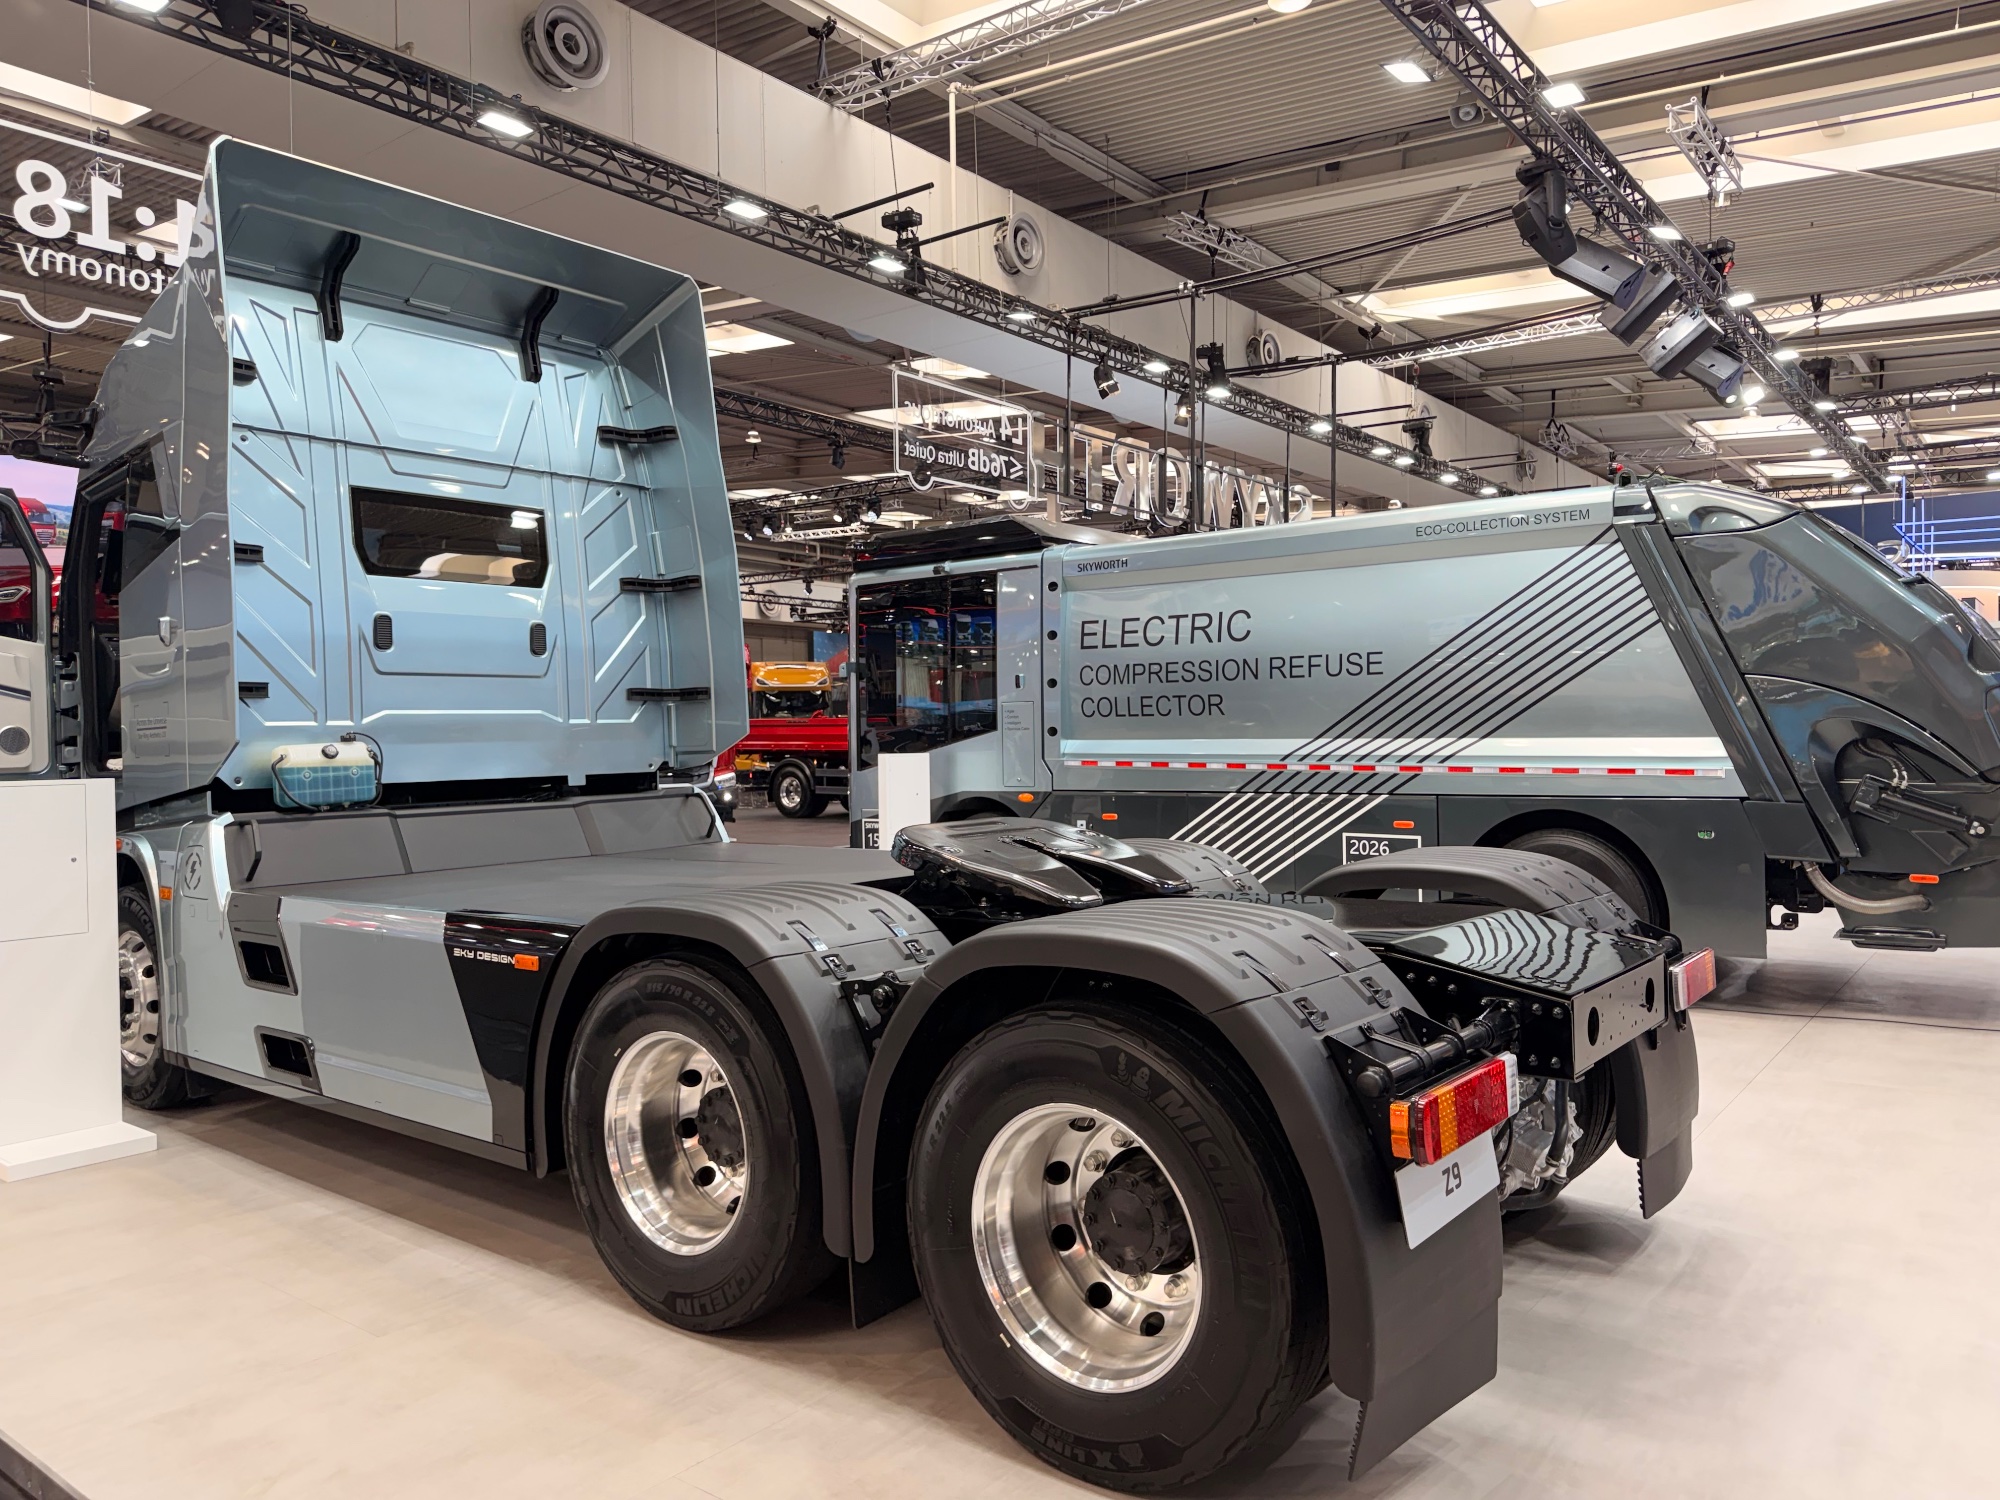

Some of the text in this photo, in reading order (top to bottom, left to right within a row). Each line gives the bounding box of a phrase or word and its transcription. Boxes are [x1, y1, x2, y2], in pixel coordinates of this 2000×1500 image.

[1415, 508, 1590, 537] ECO-COLLECTION SYSTEM
[1077, 559, 1128, 573] SKYWORTH
[1080, 609, 1252, 650] ELECTRIC
[1079, 651, 1384, 686] COMPRESSION REFUSE
[1080, 694, 1226, 718] COLLECTOR
[1349, 839, 1390, 856] 2026
[453, 948, 515, 965] SKY DESIGN
[682, 988, 693, 1000] R
[1442, 1162, 1462, 1197] Z9
